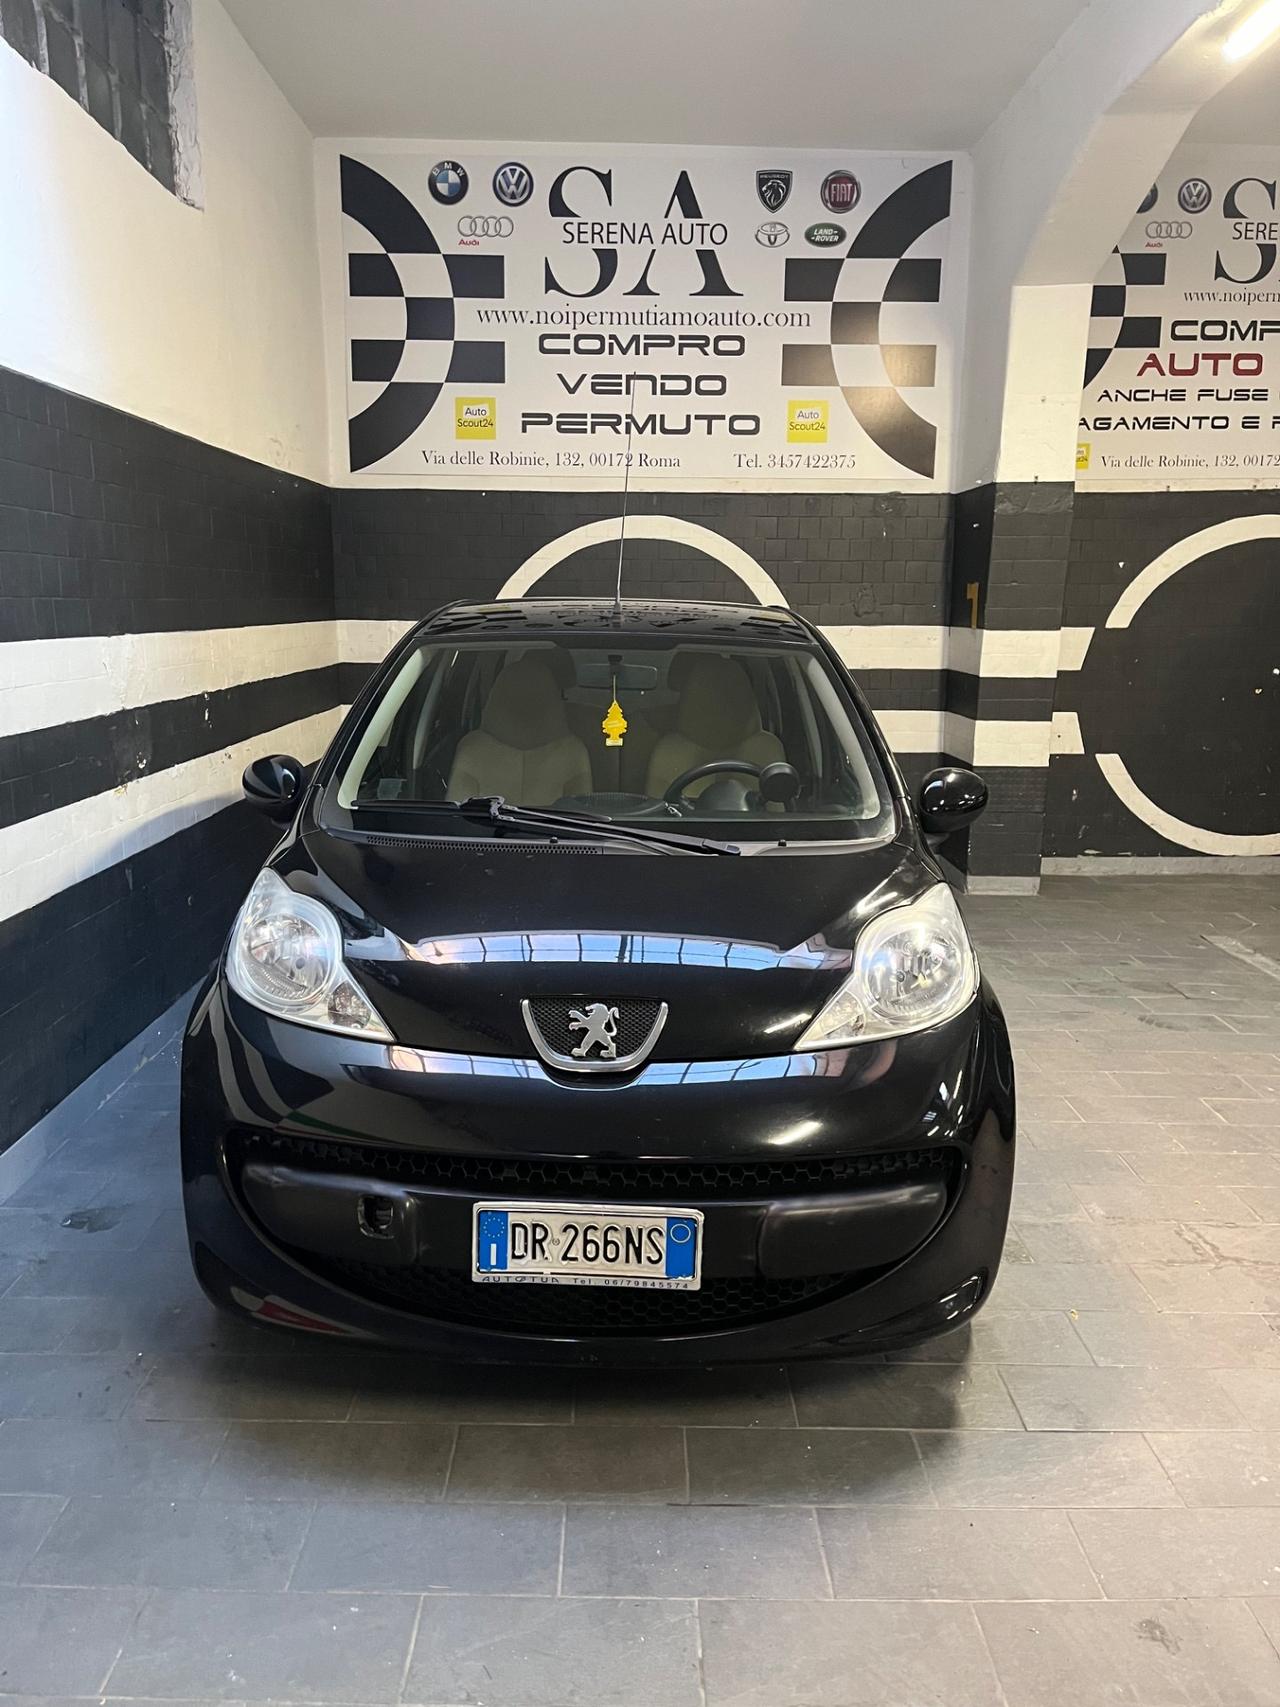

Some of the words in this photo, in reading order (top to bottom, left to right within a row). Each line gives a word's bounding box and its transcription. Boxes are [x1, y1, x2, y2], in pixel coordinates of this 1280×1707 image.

[432, 162, 465, 177] BMW
[831, 183, 853, 203] FIAT
[562, 222, 654, 244] SERENA
[661, 223, 728, 245] AUTO
[458, 238, 480, 246] Audi
[476, 304, 811, 330] www.noipermutiamoauto.com
[538, 333, 745, 356] COMPRO
[1136, 353, 1264, 377] AUTO
[556, 373, 727, 396] VENDO
[1097, 388, 1187, 403] ANCHE
[1197, 388, 1269, 402] FUSE
[464, 406, 488, 417] Auto
[797, 409, 820, 420] Auto
[456, 416, 494, 430] Scout24
[521, 412, 760, 436] PERMUTO
[789, 420, 826, 433] Scout24
[1241, 416, 1261, 430] E
[421, 450, 446, 466] Via
[449, 450, 484, 467] delle
[489, 451, 550, 469] Robinie,
[555, 453, 585, 470] 132,
[589, 453, 634, 468] 00172
[638, 454, 681, 468] Roma
[733, 453, 763, 469] Tel.
[767, 453, 856, 469] 3457422375
[1101, 455, 1120, 468] Via
[1124, 455, 1154, 468] delle
[1158, 455, 1209, 469] Robinie,
[511, 1222, 549, 1261] DR
[561, 1224, 663, 1264] 266NS
